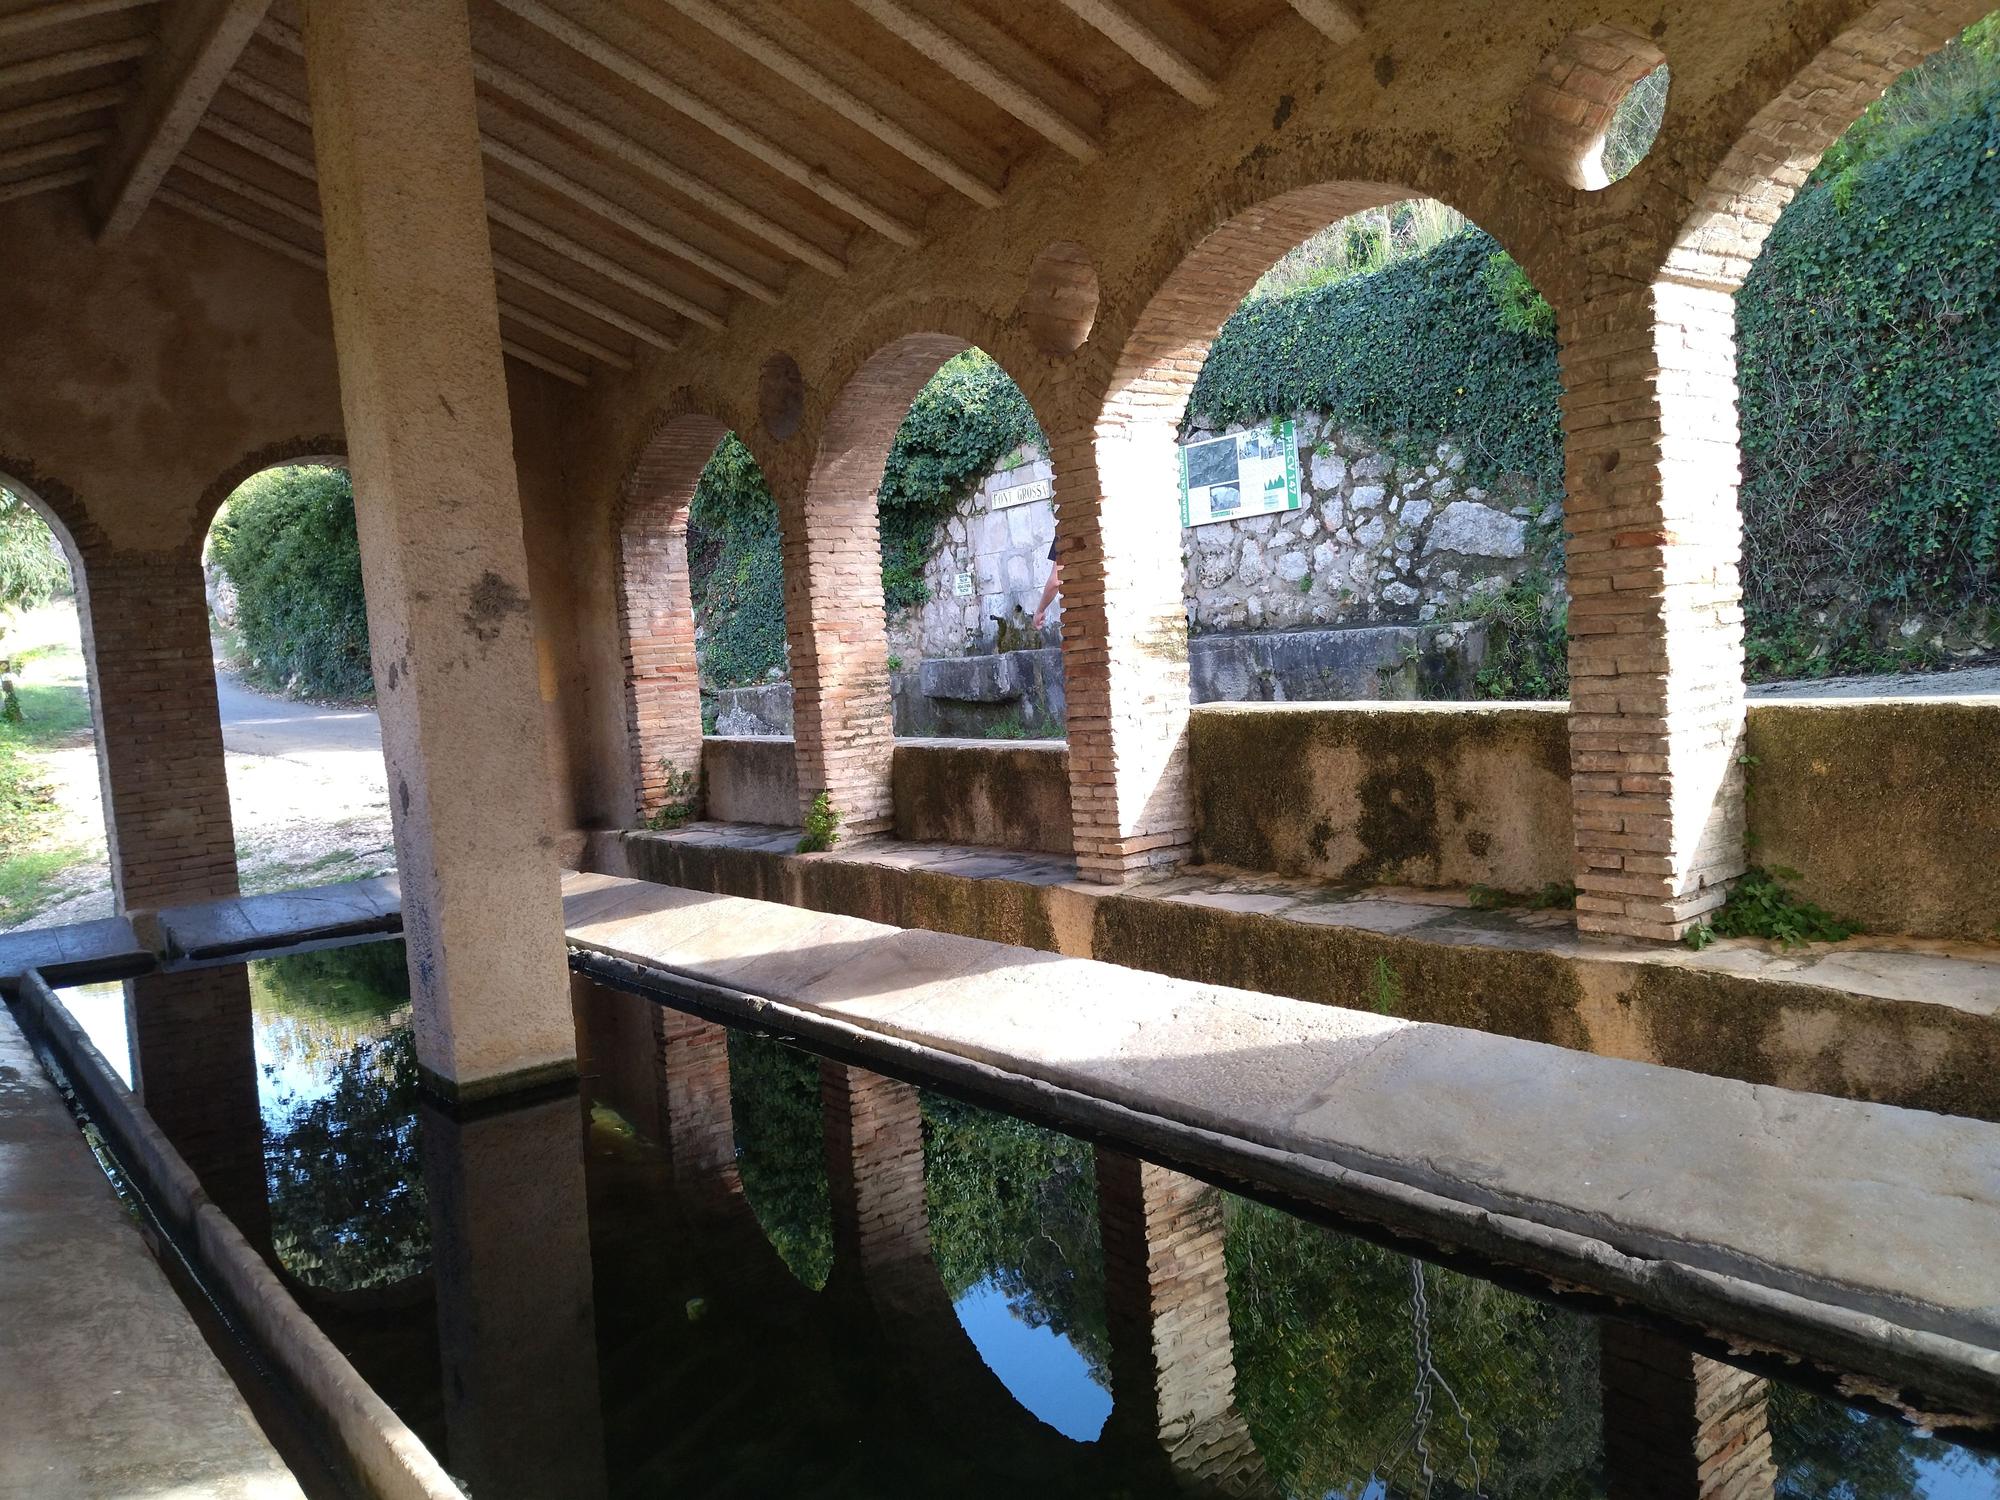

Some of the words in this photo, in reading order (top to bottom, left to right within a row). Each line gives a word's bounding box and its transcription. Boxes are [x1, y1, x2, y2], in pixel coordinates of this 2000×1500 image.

[1285, 436, 1295, 470] PR-CV
[993, 492, 1012, 506] FONT
[1017, 484, 1048, 500] GROSSA
[1288, 474, 1296, 494] 147
